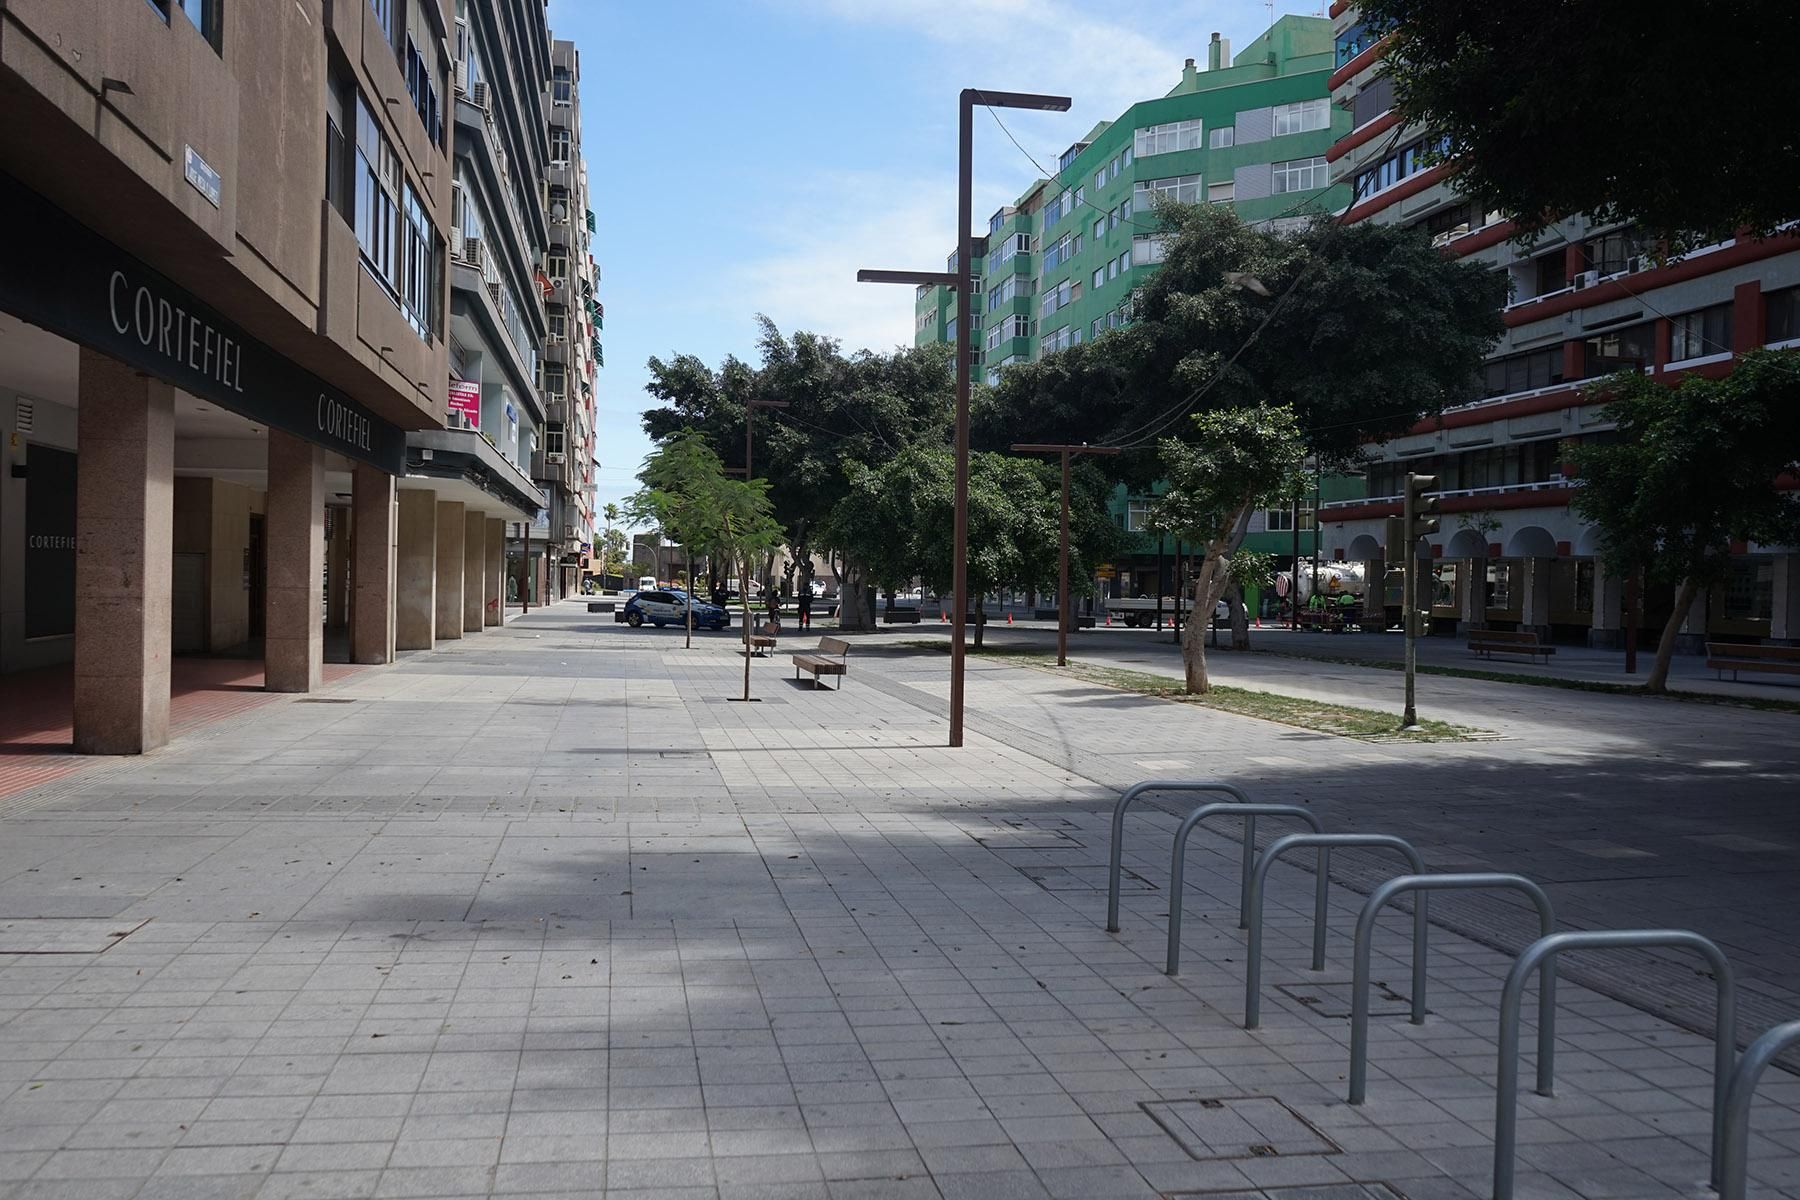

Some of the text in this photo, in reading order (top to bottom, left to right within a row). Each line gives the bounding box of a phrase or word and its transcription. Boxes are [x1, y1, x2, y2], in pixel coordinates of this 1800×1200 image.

[110, 270, 243, 392] CORTEFIEL
[318, 393, 371, 451] CORTEFIEL
[30, 535, 76, 549] CORTEFIE
